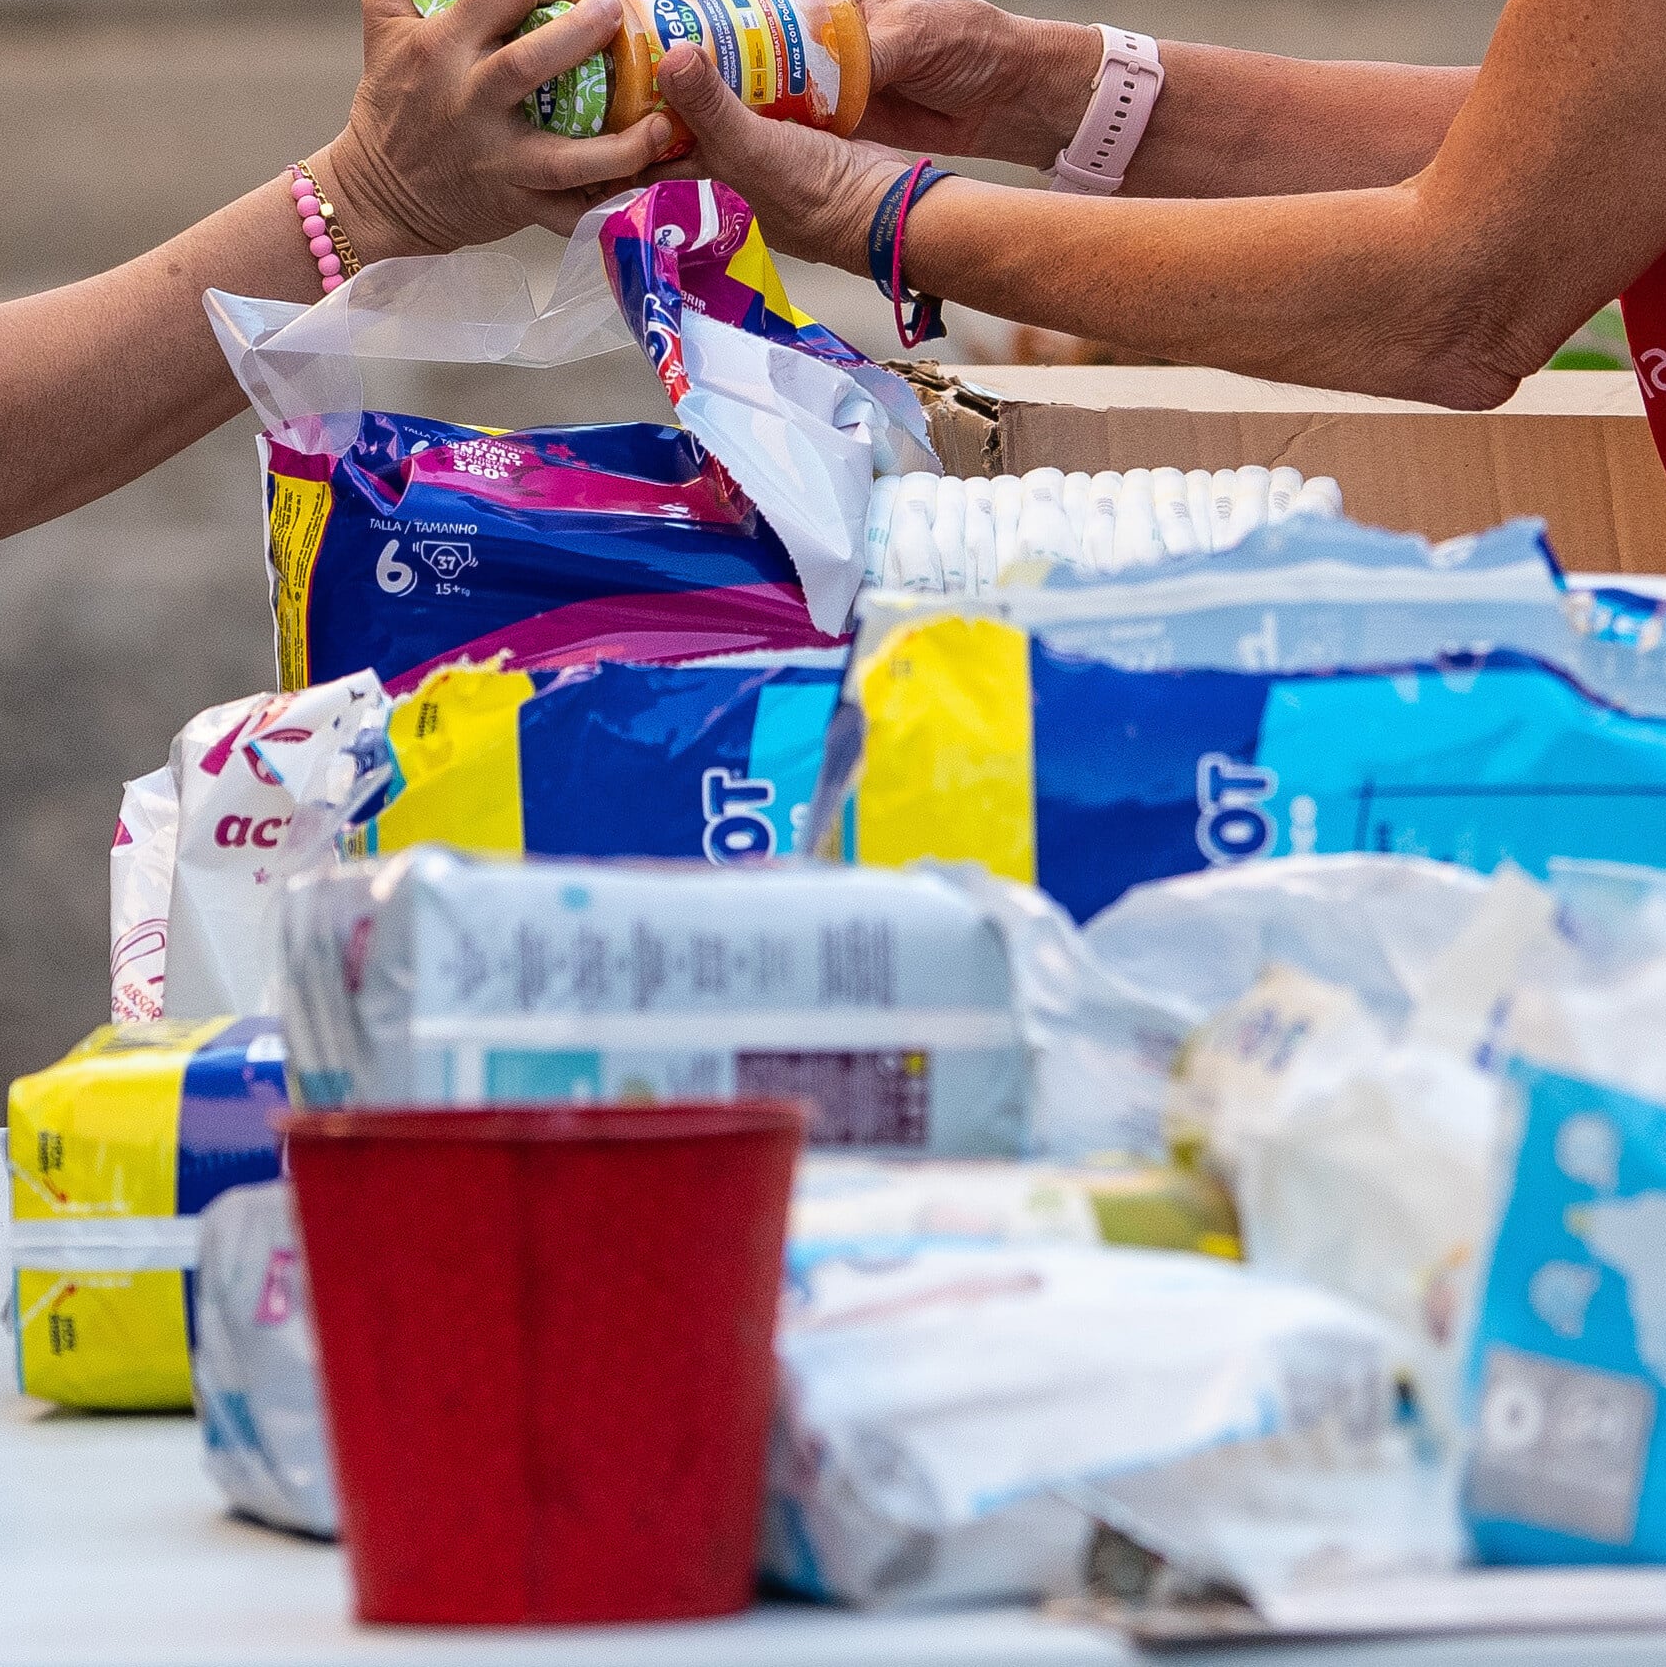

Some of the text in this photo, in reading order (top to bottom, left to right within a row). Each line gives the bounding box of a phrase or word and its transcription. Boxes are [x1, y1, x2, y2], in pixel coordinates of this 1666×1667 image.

[777, 0, 792, 20] Pollo
[682, 4, 702, 44] Baby
[789, 24, 797, 43] con
[792, 47, 801, 78] Arroz
[369, 518, 402, 532] TALLA
[414, 521, 478, 535] TAMANHO
[375, 539, 413, 593] 6
[437, 555, 457, 571] 37
[213, 812, 292, 850] ac
